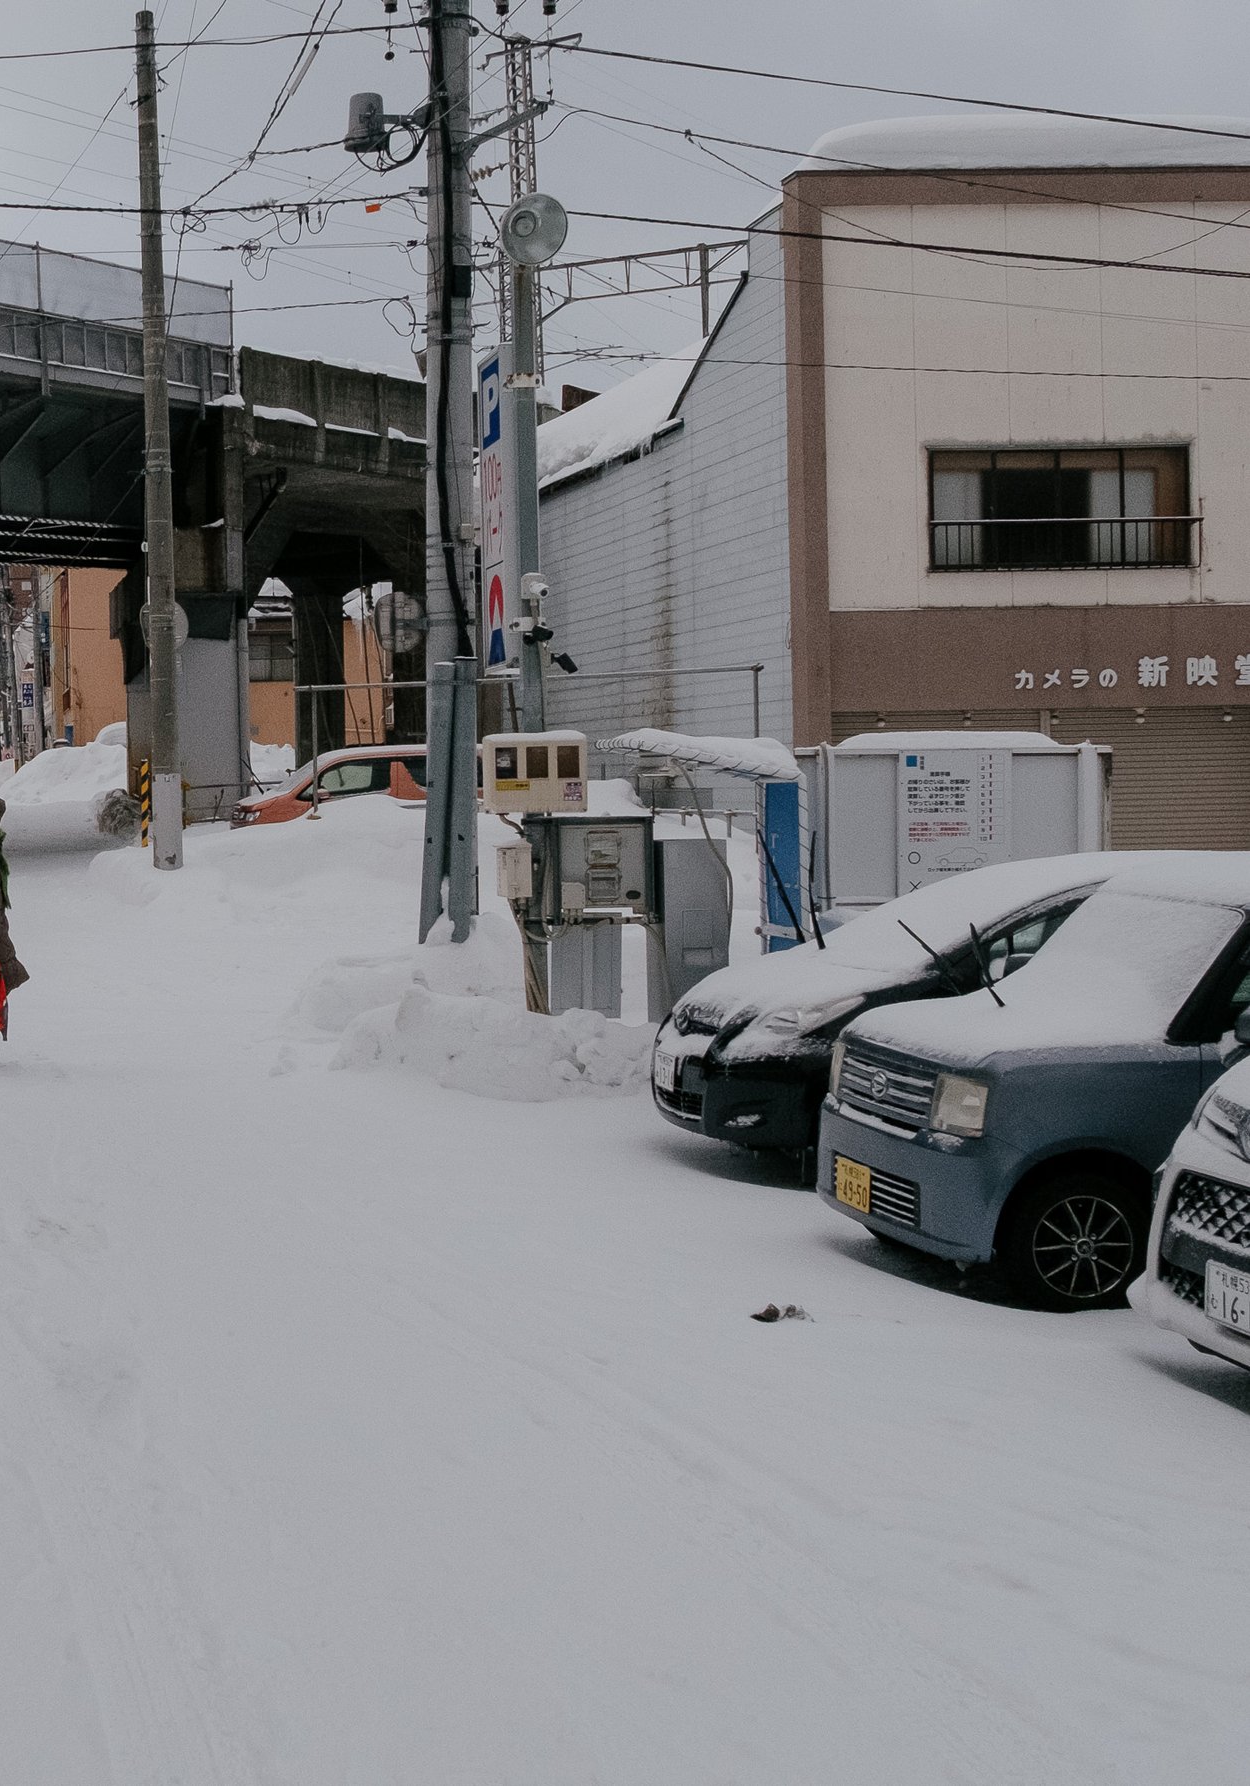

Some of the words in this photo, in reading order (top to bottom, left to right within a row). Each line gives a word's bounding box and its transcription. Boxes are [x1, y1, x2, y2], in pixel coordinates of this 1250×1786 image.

[1014, 668, 1118, 690] カメラの
[843, 1179, 868, 1209] 49-50
